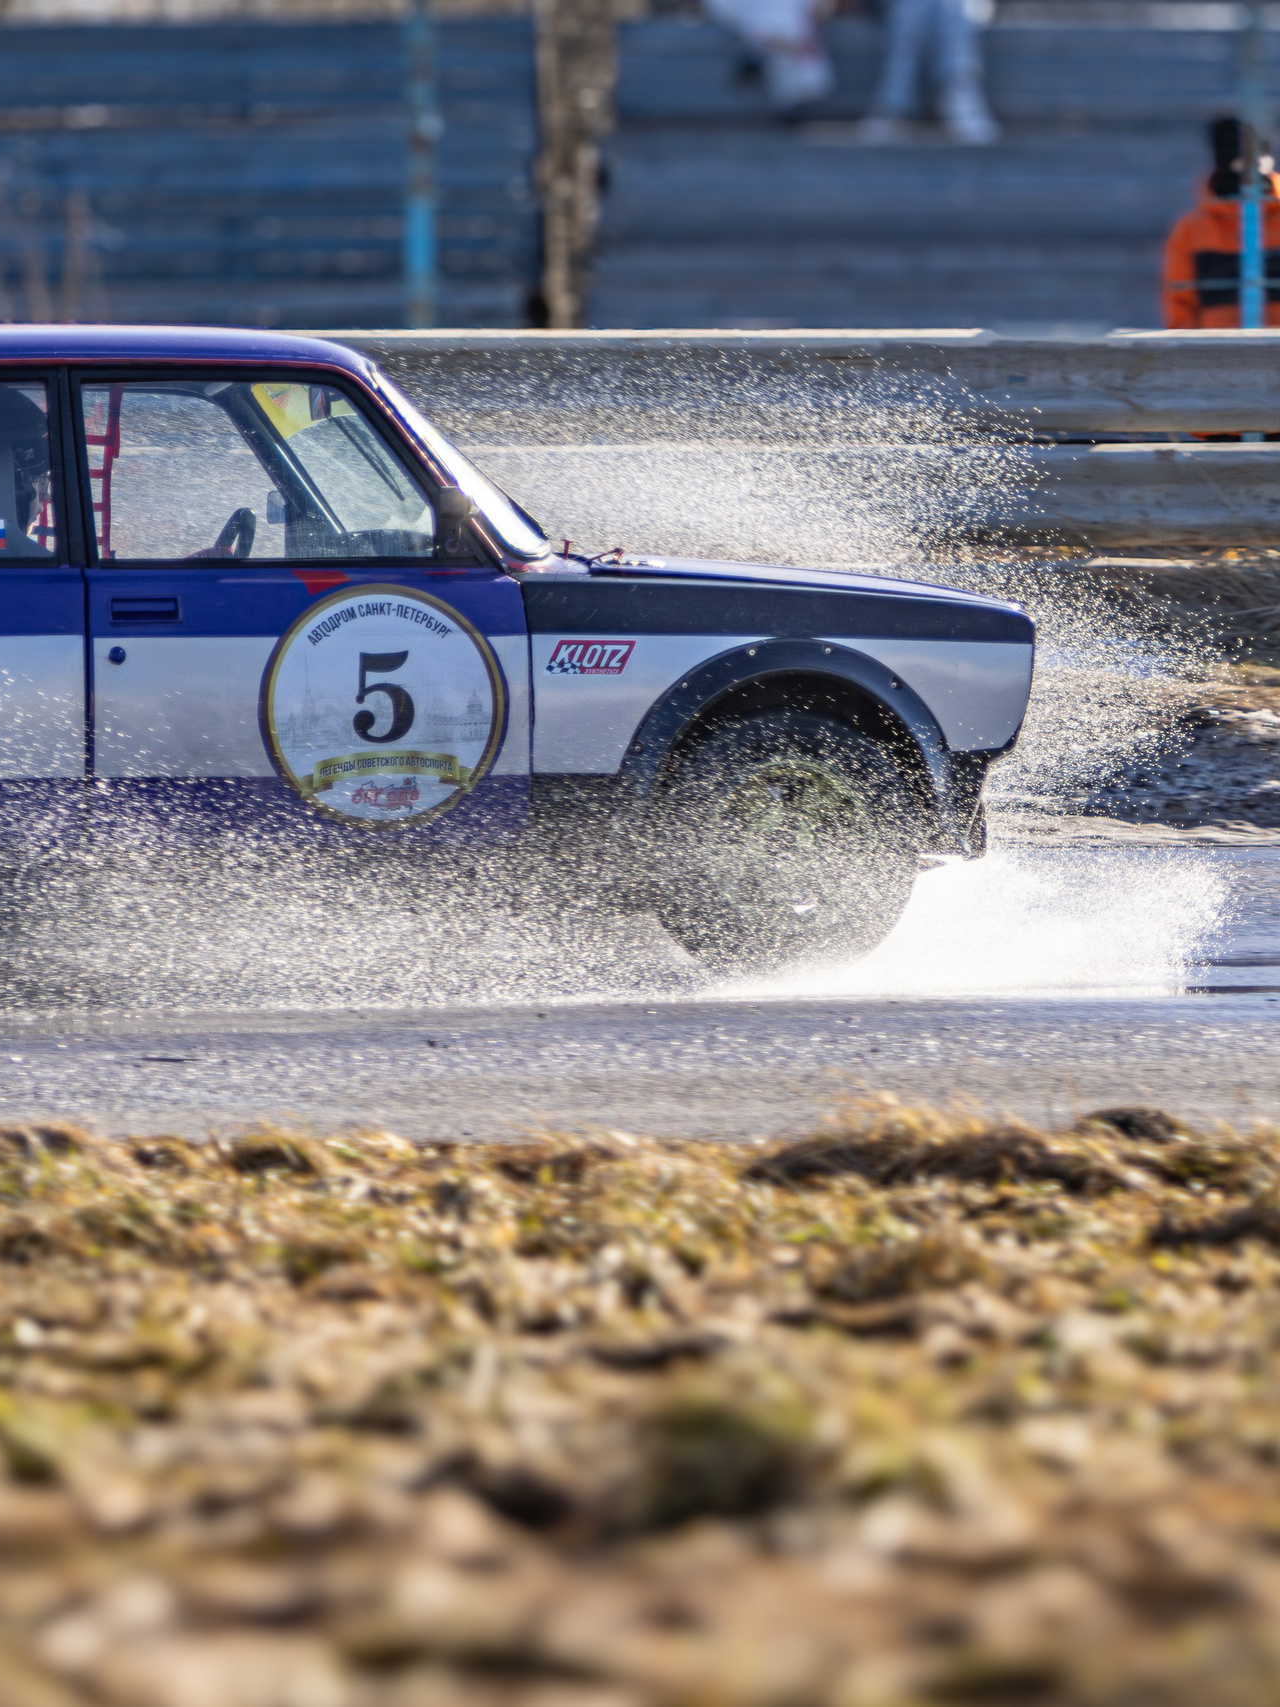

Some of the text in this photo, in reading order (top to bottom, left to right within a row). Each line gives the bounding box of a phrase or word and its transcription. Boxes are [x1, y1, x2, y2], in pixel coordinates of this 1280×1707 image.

[307, 602, 453, 646] АВТОДРОМ САНКТ-ПЕТЕРБУРГ
[555, 644, 631, 668] KLOTZ
[353, 650, 415, 743] 5
[320, 756, 454, 778] ЛЕГЕНДЫ СОВЕТСКОГО АВТОСПОРТА
